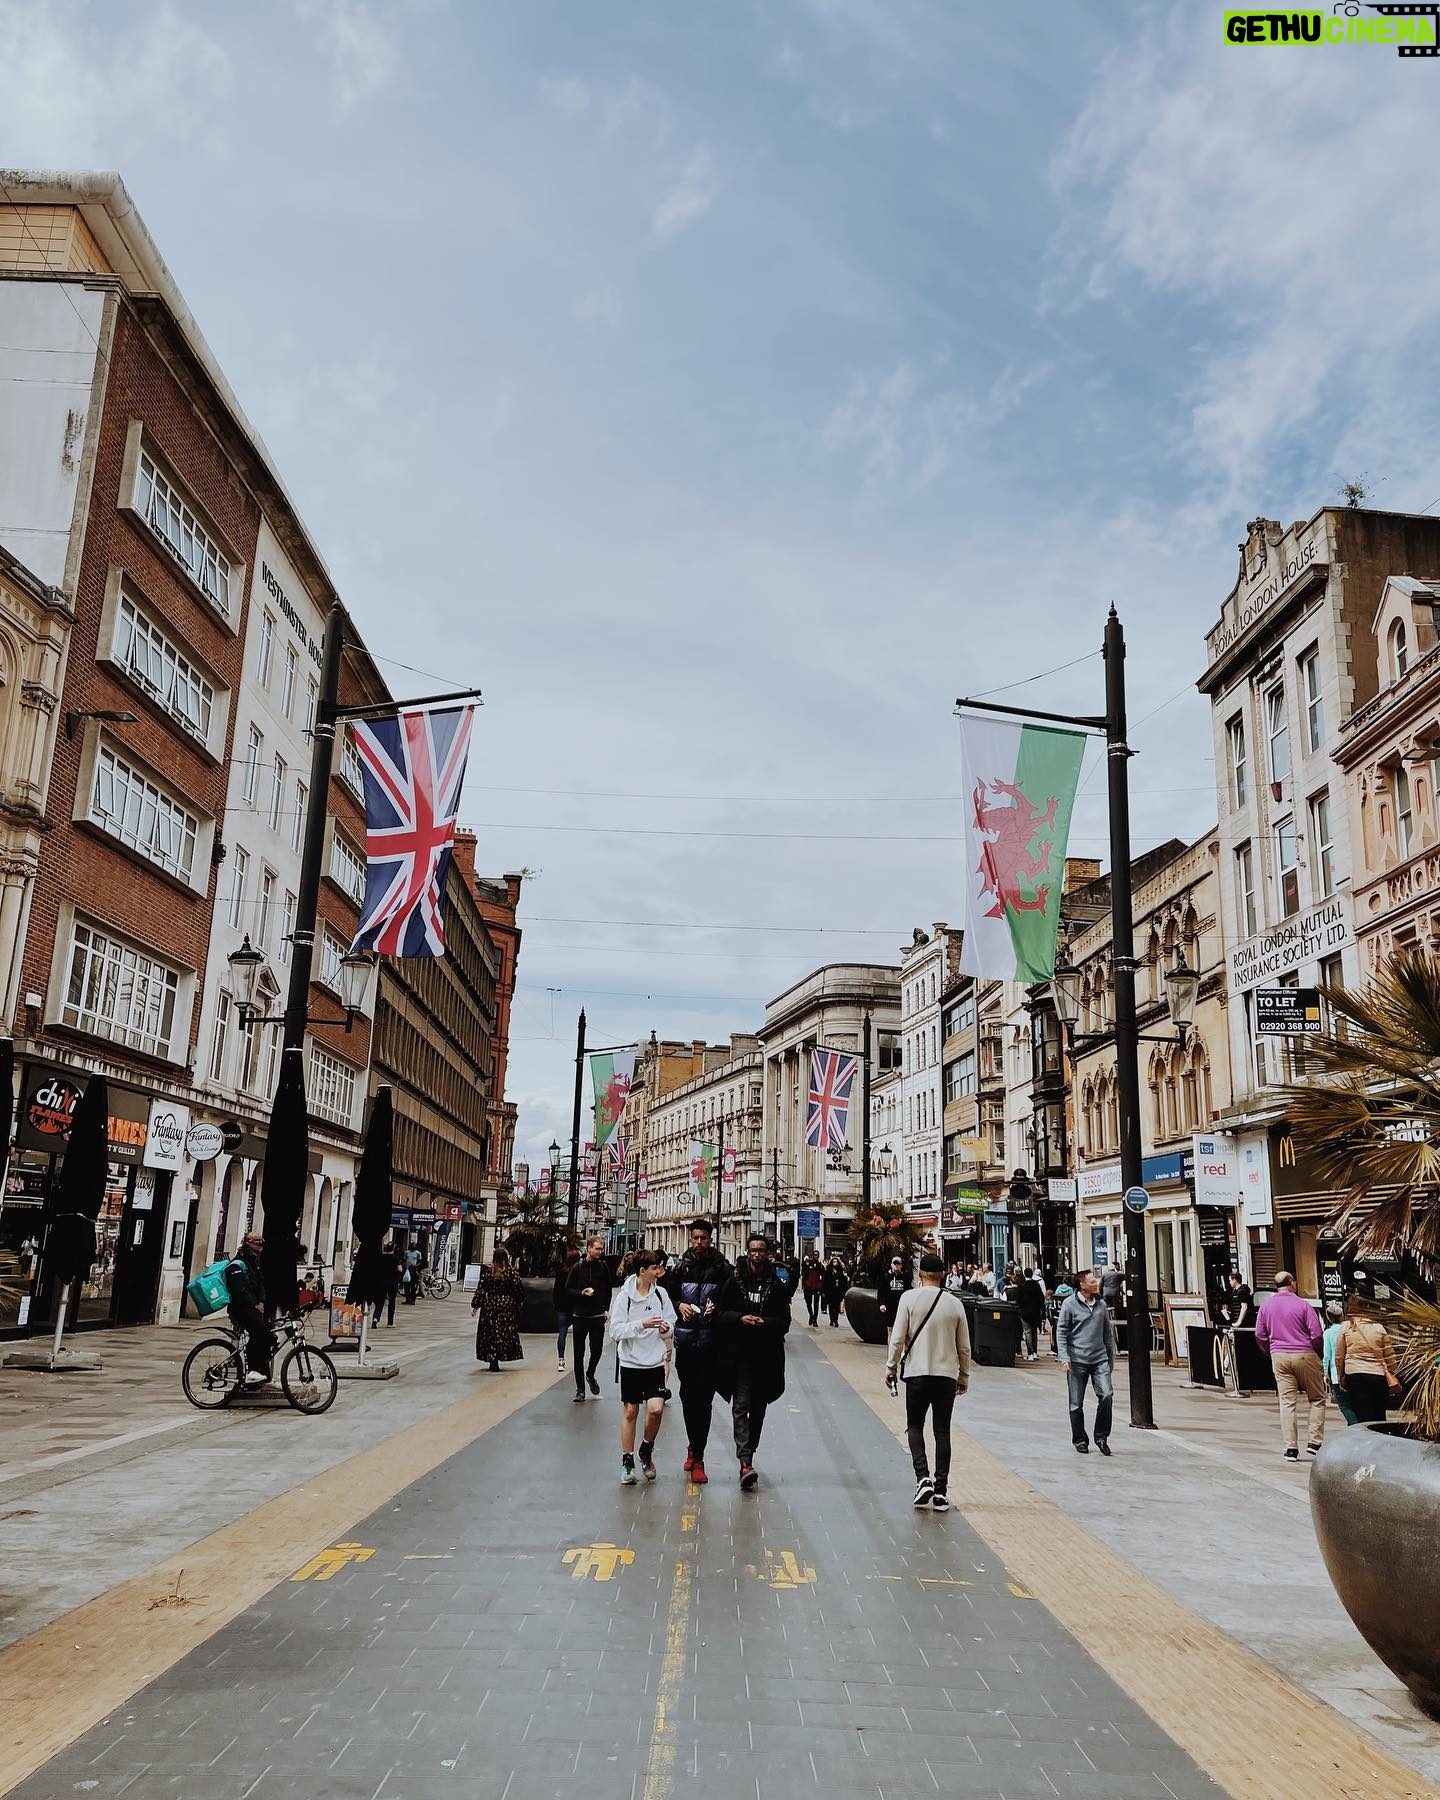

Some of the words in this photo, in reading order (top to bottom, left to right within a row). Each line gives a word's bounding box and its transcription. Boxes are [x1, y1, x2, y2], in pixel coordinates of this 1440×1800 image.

[262, 560, 307, 647] WESTMINSTER
[308, 637, 323, 669] HOU
[1214, 624, 1238, 658] ROYAL
[1240, 579, 1278, 630] LONDON
[1233, 945, 1257, 969] ROYAL
[1260, 924, 1297, 956] LONDON
[1300, 901, 1343, 935] MUTUAL
[1234, 953, 1280, 988] INSURANCE
[1282, 932, 1323, 966] SOCIETY
[1327, 923, 1347, 946] LTD.
[1258, 997, 1273, 1007] TO
[1275, 997, 1296, 1007] LET
[1260, 1022, 1286, 1031] 02920
[1287, 1022, 1303, 1031] 368
[1304, 1022, 1320, 1031] 900
[107, 1116, 148, 1147] AMES
[152, 1115, 184, 1148] Fantasy
[189, 1131, 221, 1143] Fantasy
[1201, 1144, 1214, 1153] tsr
[832, 1155, 842, 1163] OF
[1203, 1163, 1227, 1176] red
[136, 1176, 155, 1197] tasy
[1085, 1174, 1102, 1189] TESCO
[1323, 1270, 1342, 1286] cash
